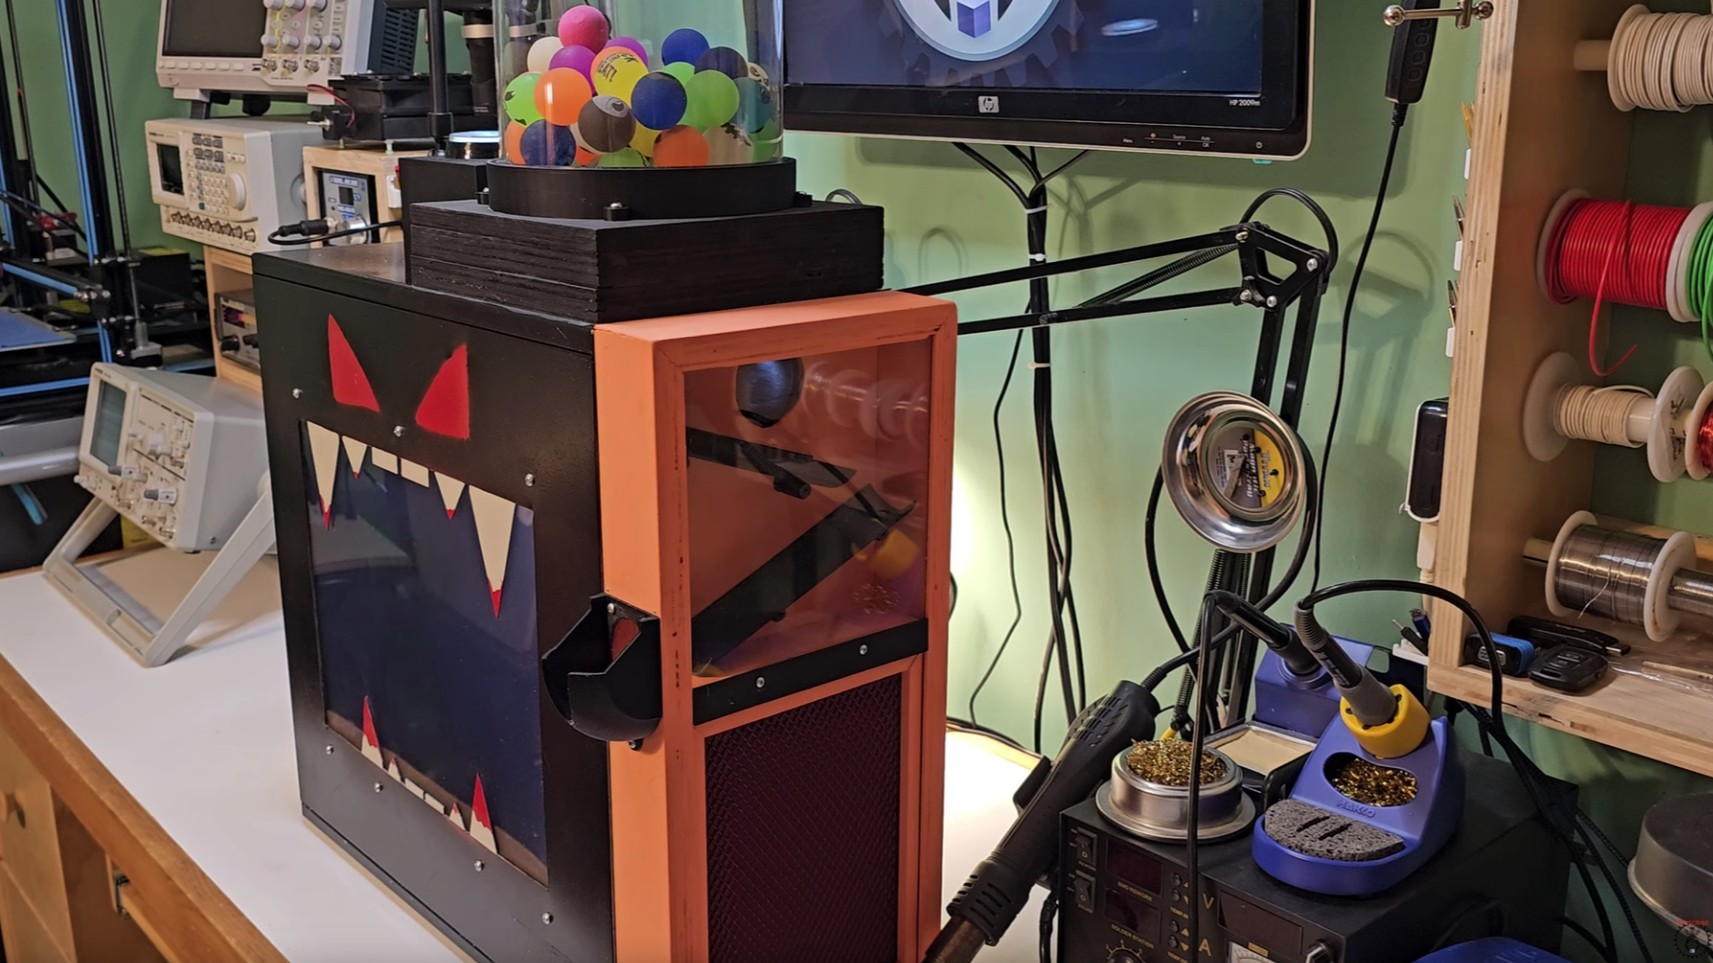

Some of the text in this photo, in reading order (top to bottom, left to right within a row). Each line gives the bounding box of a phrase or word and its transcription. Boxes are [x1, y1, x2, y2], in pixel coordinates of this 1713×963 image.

[1249, 443, 1259, 492] Magntic
[1202, 892, 1214, 909] V
[1198, 938, 1211, 957] A
